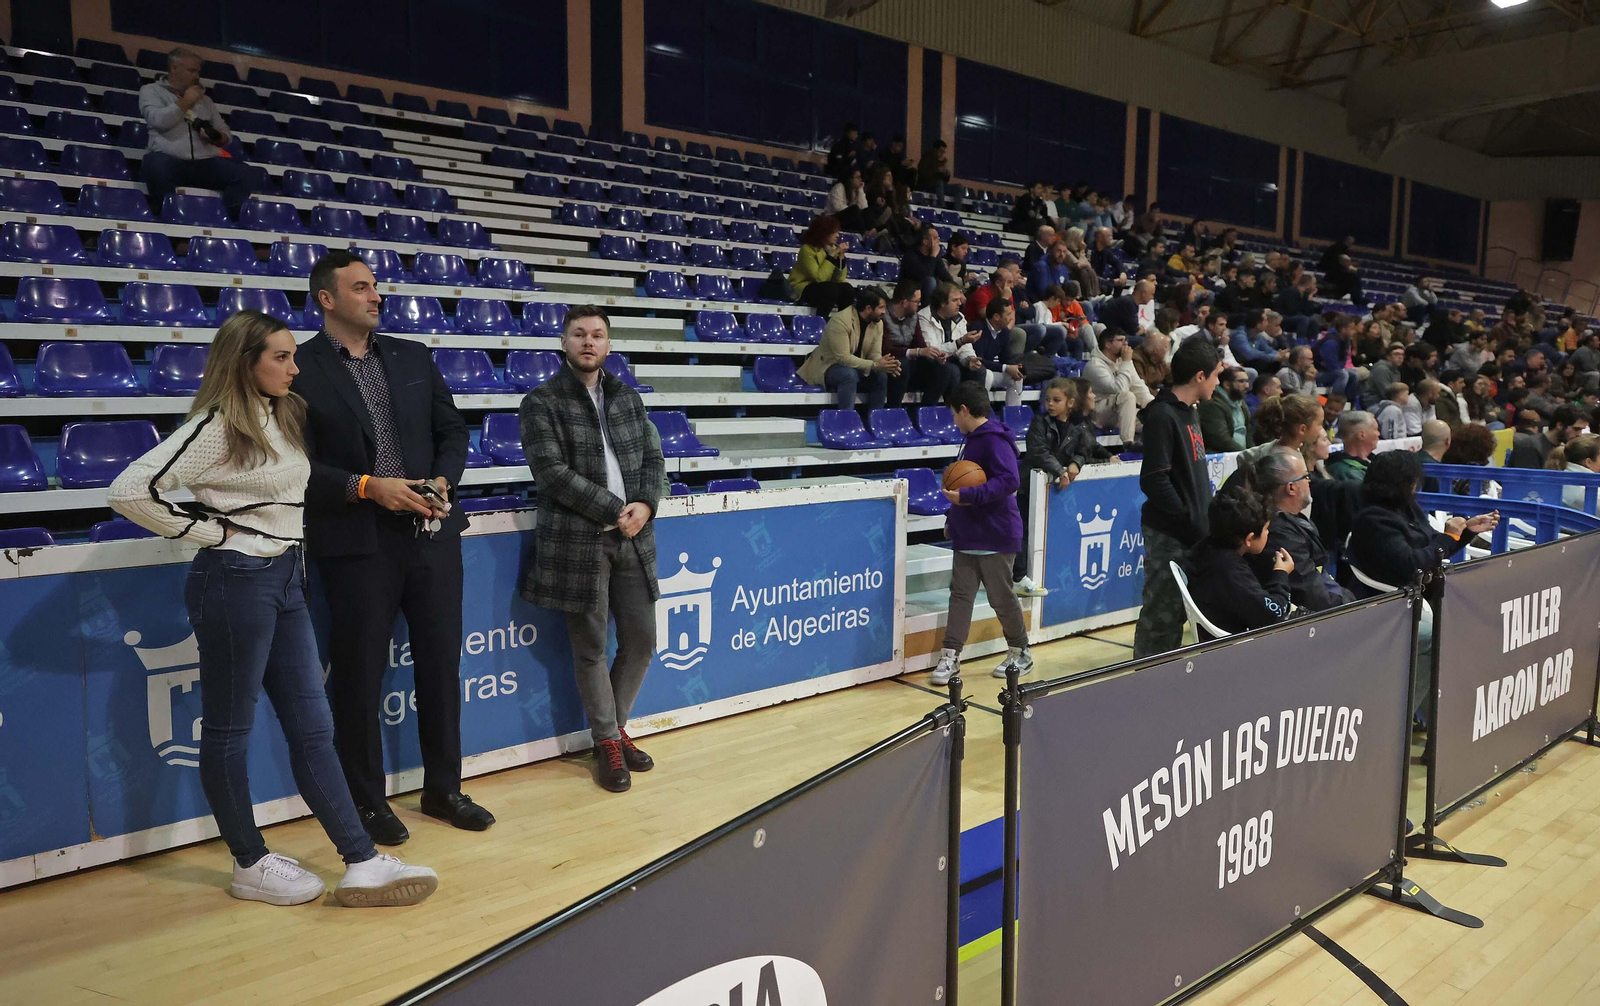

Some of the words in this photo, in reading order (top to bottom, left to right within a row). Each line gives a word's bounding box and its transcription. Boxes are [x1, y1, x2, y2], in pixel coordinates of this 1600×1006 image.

[730, 567, 883, 616] Ayuntamiento
[1118, 561, 1132, 579] de
[731, 628, 756, 651] de
[763, 606, 870, 646] Algeciras
[1500, 585, 1562, 654] TALLER
[1472, 662, 1539, 743] AARON
[1540, 648, 1574, 707] CAR
[1102, 738, 1212, 870] MESÓN
[1222, 715, 1271, 791] LAS
[1276, 705, 1363, 769] DUELAS
[1216, 809, 1274, 889] 1988
